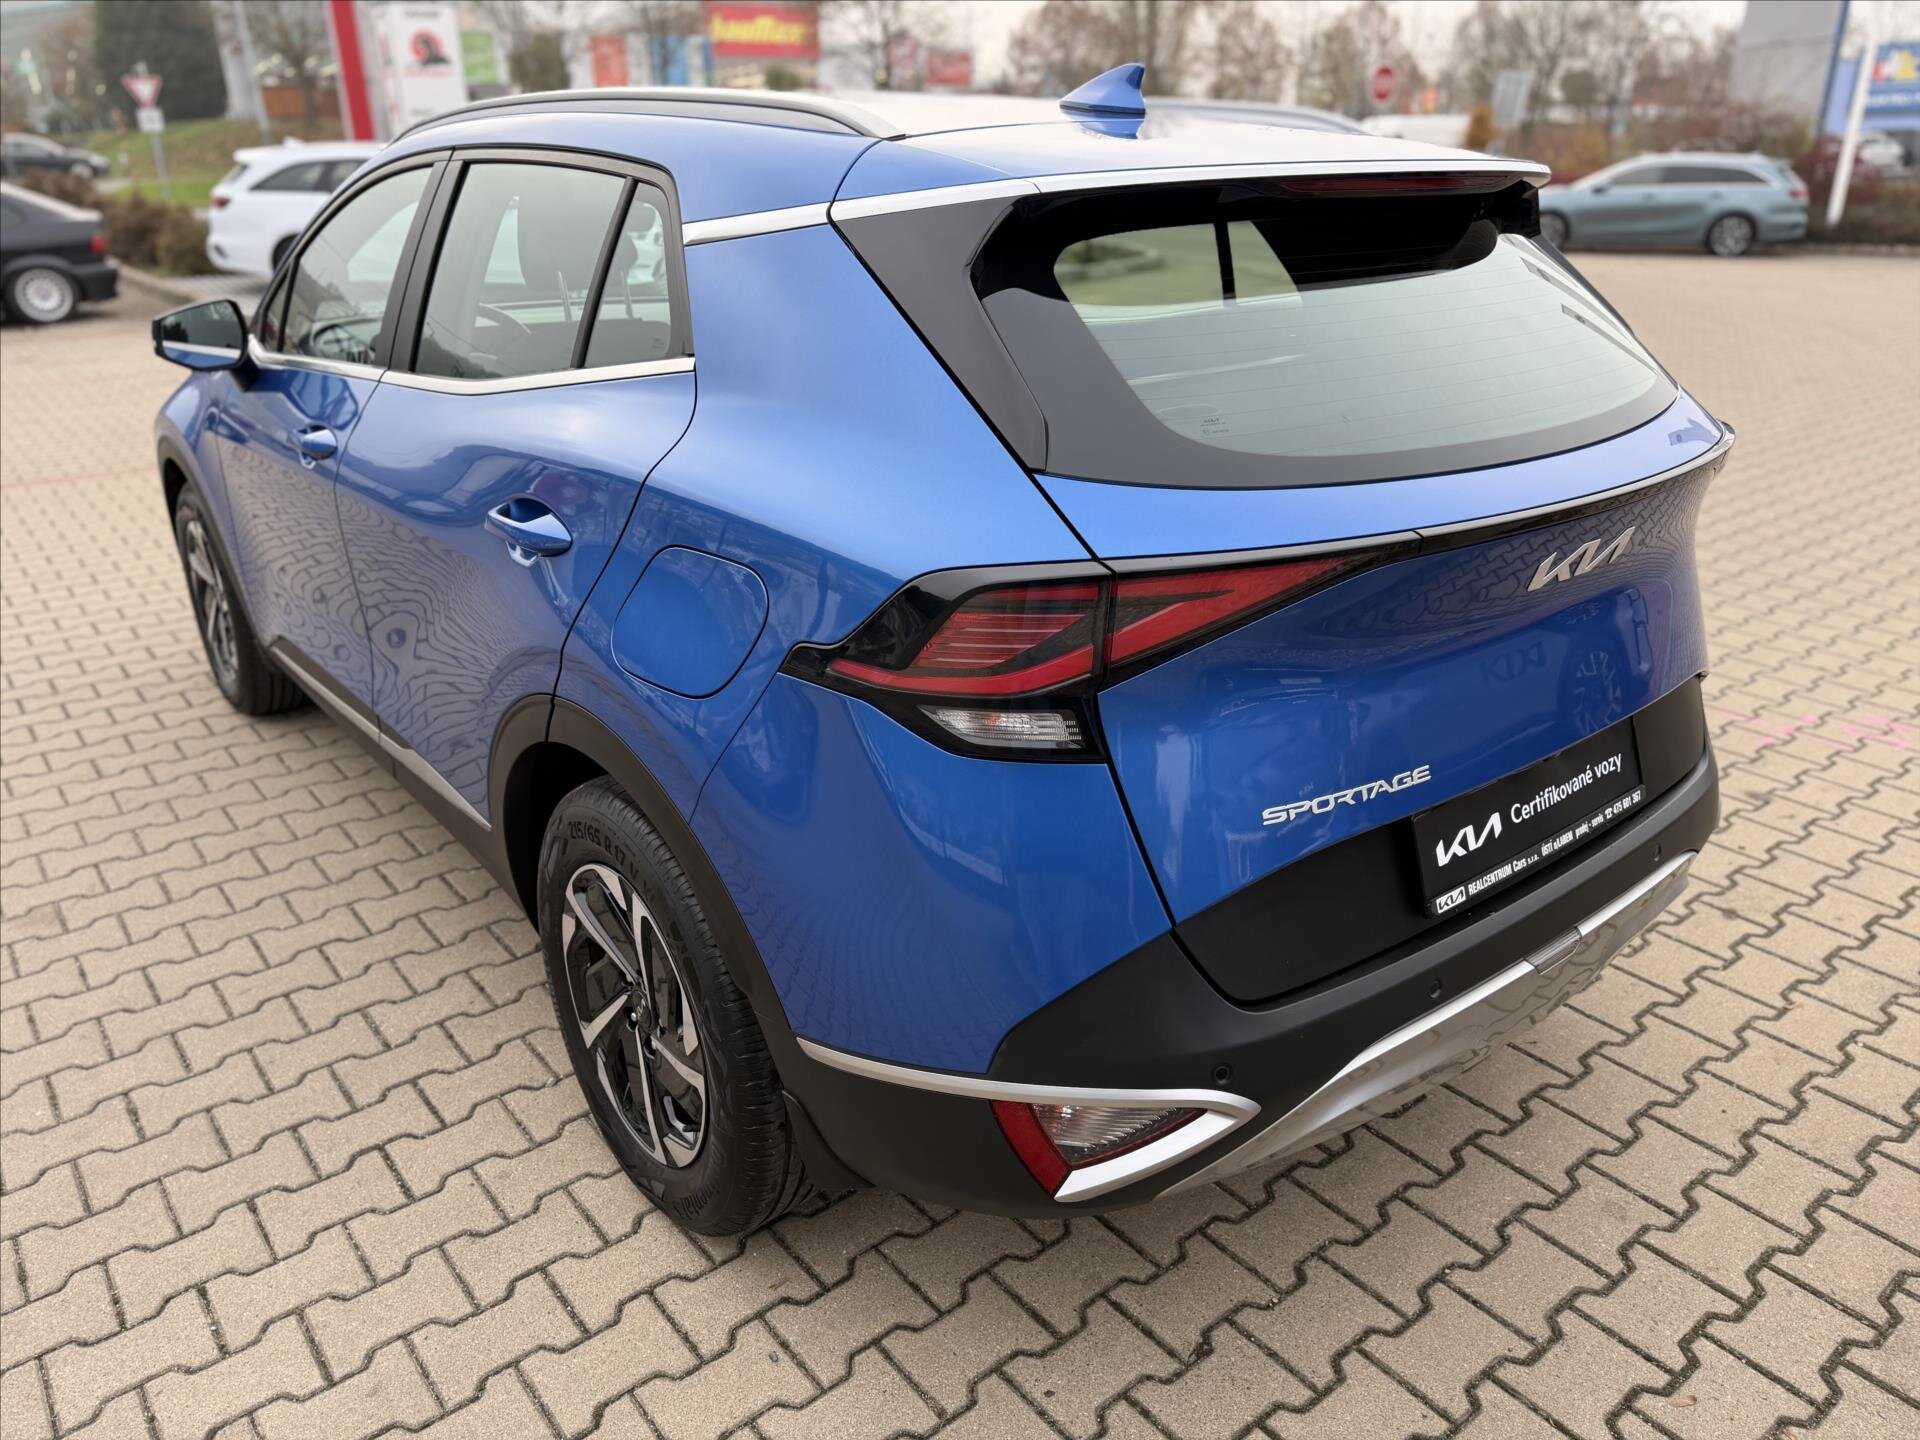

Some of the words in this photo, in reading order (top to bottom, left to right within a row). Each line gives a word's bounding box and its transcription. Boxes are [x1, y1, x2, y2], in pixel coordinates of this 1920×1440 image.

[1527, 526, 1636, 592] KIA
[1262, 764, 1432, 826] SPORTAGE
[1435, 811, 1503, 868] KIA
[1510, 765, 1593, 824] Certifikované
[1594, 752, 1622, 774] vozy
[568, 821, 602, 847] 215/65
[1467, 863, 1513, 896] REALCENTRUM
[1512, 858, 1527, 872] Cars
